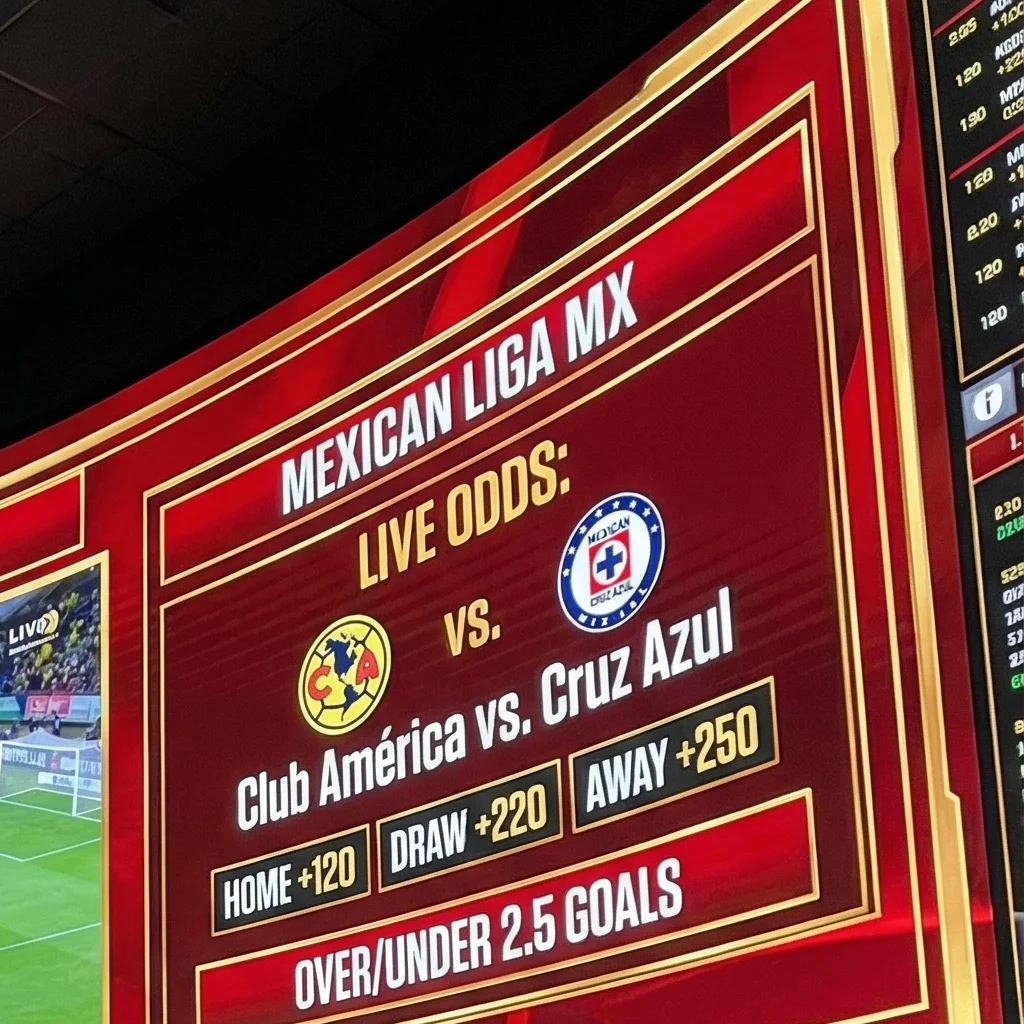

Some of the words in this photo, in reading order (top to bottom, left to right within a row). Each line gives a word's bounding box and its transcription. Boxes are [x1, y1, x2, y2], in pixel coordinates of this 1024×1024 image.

[975, 258, 1003, 284] 120
[281, 373, 452, 515] MEXICAN
[462, 316, 556, 422] LIGA
[564, 260, 638, 362] MX
[358, 498, 437, 590] LIVE
[446, 439, 571, 548] ODDS:
[443, 598, 501, 657] VS.
[237, 762, 310, 831] Club
[318, 711, 466, 804] América
[474, 691, 531, 752] vs.
[541, 645, 632, 726] Cruz
[641, 586, 734, 688] Azul
[585, 738, 669, 812] AWAY
[675, 705, 760, 774] +250
[389, 809, 468, 874] DRAW
[474, 783, 547, 844] +220
[223, 865, 292, 920] HOME
[297, 845, 356, 897] +120
[294, 913, 492, 1011] OVER/UNDER
[501, 892, 556, 963] 2.5
[565, 858, 682, 945] GOALS
